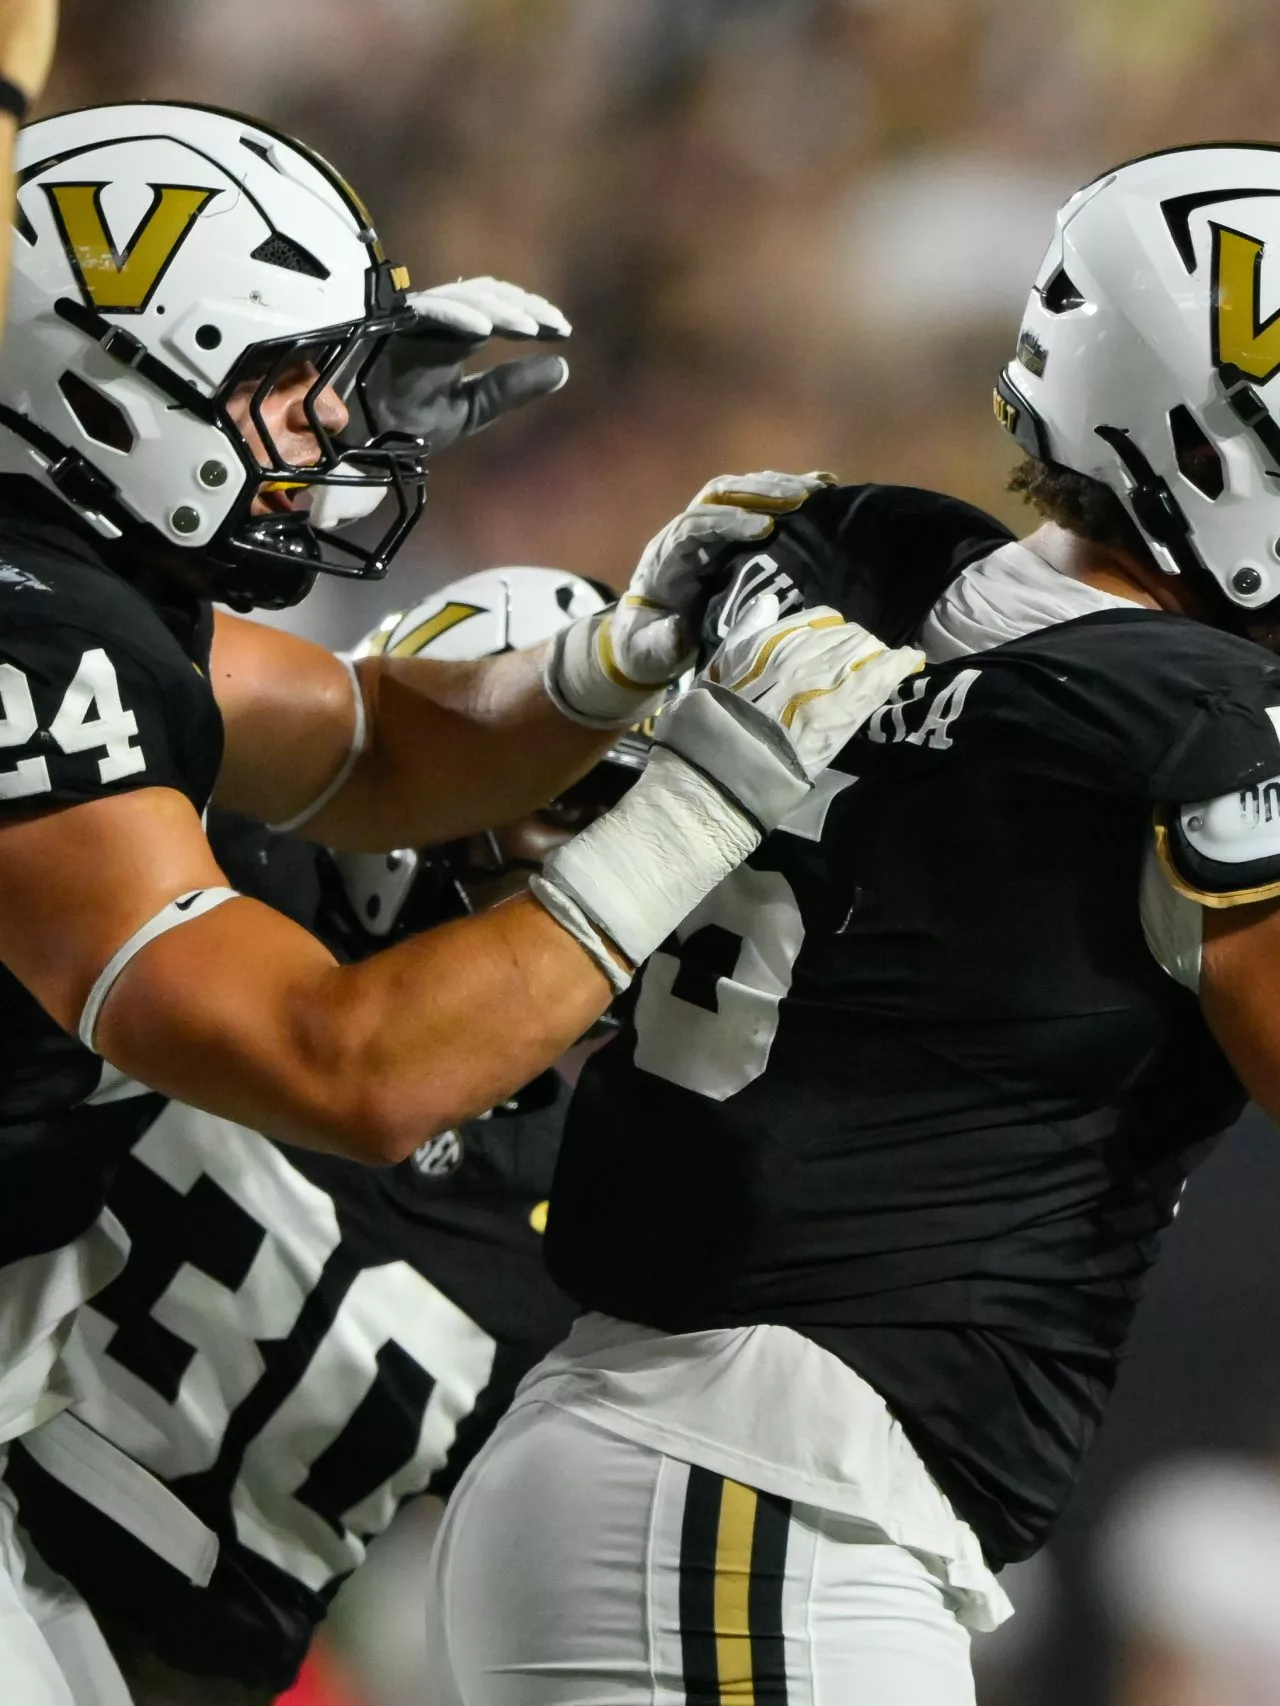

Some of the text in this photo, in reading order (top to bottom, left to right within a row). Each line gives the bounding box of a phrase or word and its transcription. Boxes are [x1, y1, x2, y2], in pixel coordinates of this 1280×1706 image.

[38, 181, 226, 314] V
[0, 647, 147, 801] 24
[59, 1098, 498, 1594] 30
